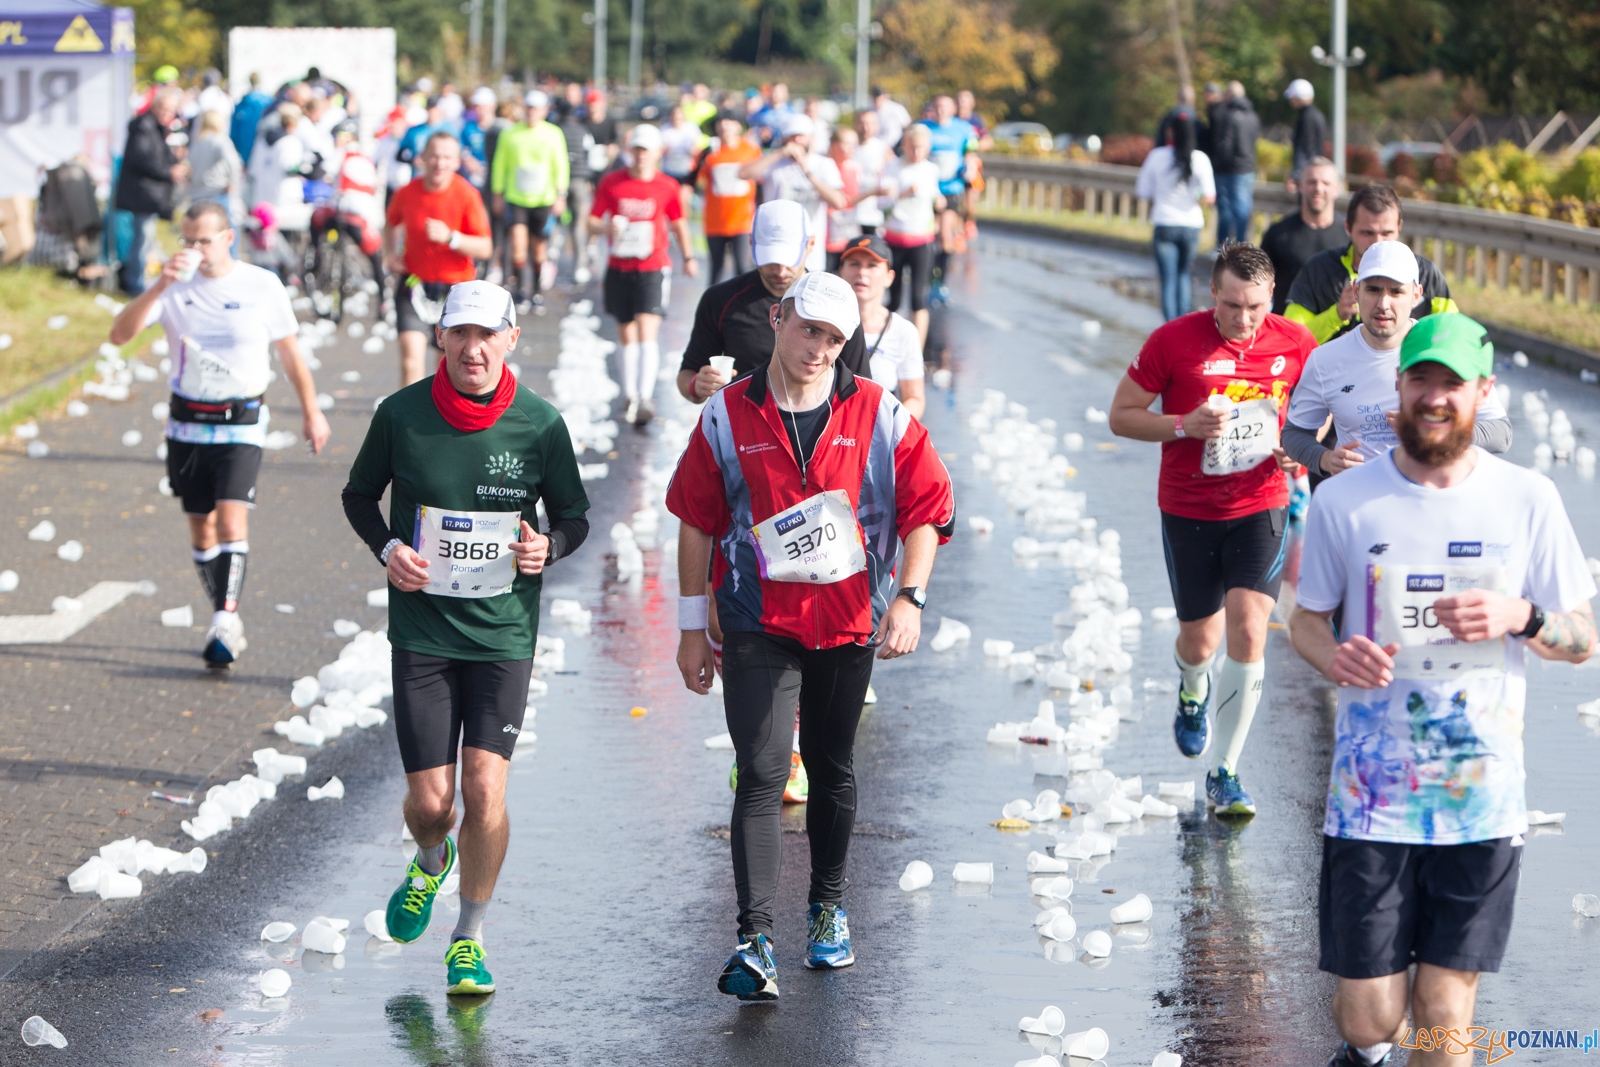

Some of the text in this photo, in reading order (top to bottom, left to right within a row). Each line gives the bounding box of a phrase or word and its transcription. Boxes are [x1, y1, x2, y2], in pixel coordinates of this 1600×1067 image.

[1357, 404, 1382, 414] SIŁA
[784, 522, 837, 561] 3370
[438, 539, 499, 560] 3868
[1368, 543, 1390, 555] 4F
[451, 564, 484, 573] Roman
